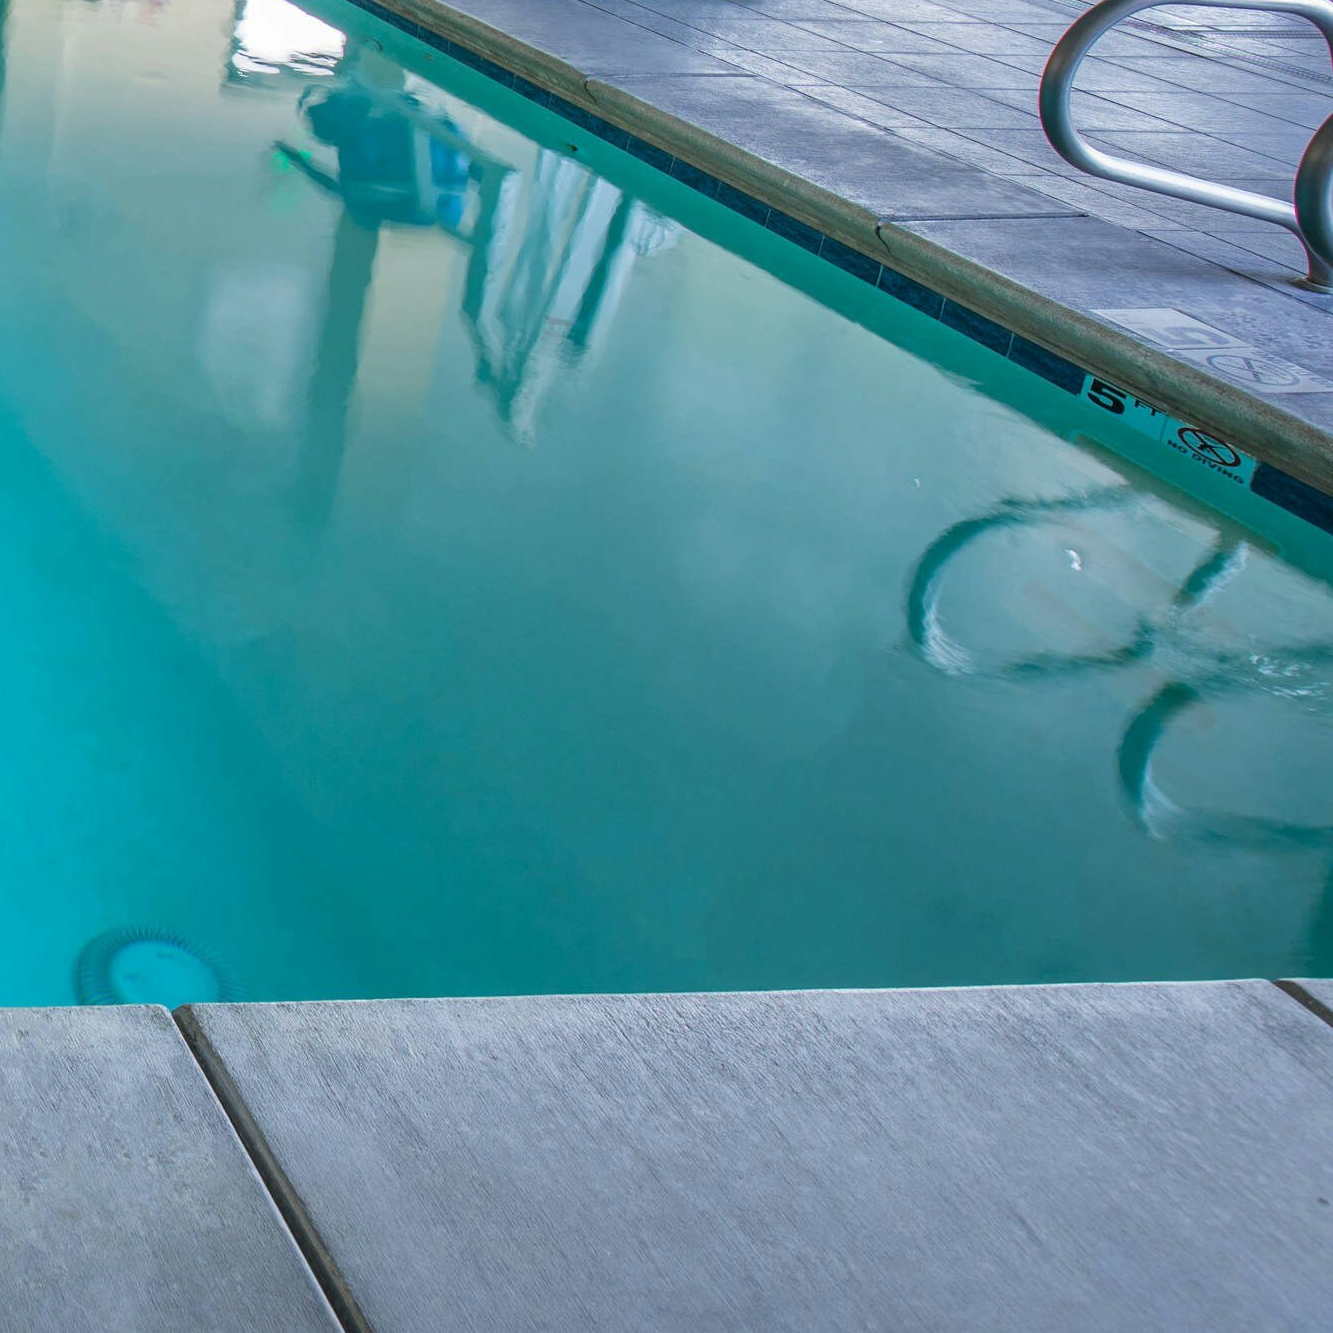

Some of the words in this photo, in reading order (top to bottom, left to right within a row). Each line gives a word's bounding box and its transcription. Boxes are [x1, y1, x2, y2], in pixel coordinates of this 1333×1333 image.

[1087, 378, 1127, 415] 5
[1167, 439, 1188, 454] NO
[1191, 453, 1245, 484] DIVING
